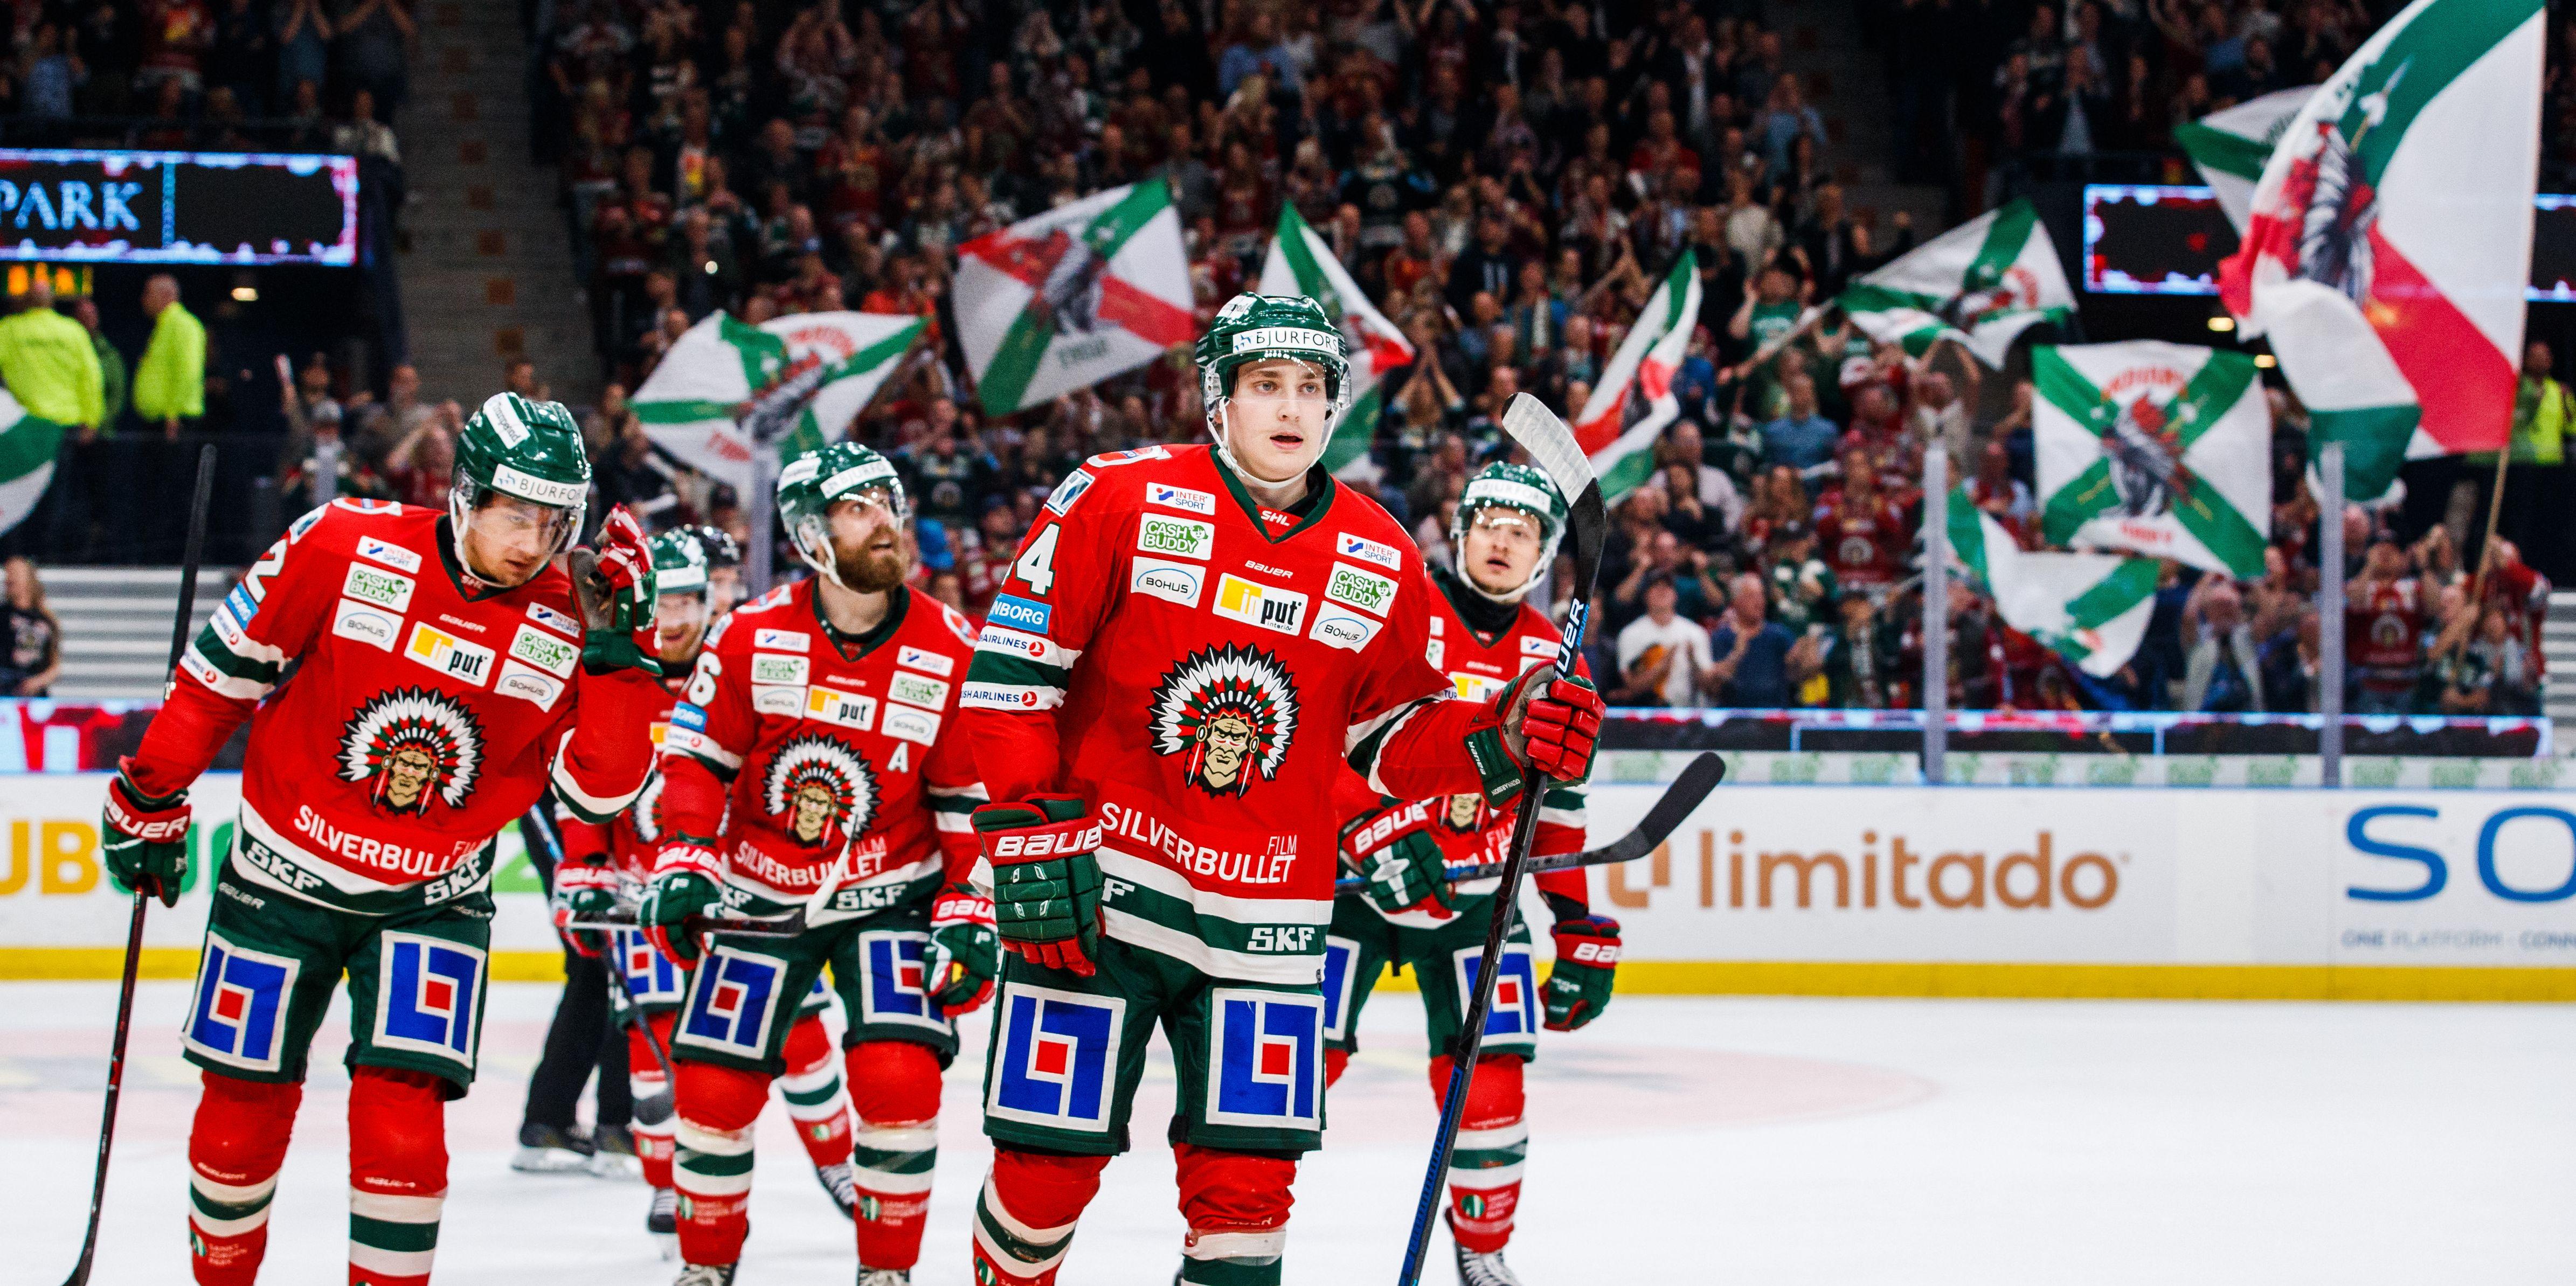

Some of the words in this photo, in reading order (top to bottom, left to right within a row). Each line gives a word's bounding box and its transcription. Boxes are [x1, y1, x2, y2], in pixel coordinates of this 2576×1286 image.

[1256, 329, 1339, 353] BJURFORS
[1175, 498, 1205, 511] SPORT
[1176, 490, 1206, 503] INTER
[1146, 521, 1188, 539] CASH
[1261, 510, 1290, 526] SHL
[1144, 534, 1198, 554] BUDDY
[1365, 543, 1393, 558] INTER
[1002, 523, 1060, 596] 4
[1244, 560, 1293, 579] BAUER
[1365, 551, 1392, 565] SPORT
[349, 580, 397, 604] BUDDY
[352, 569, 392, 592] CASH
[1146, 577, 1189, 594] BOHUS
[1336, 571, 1375, 593] CASH
[1241, 588, 1298, 626] input
[1331, 582, 1382, 609] BUDDY
[991, 600, 1045, 625] NBORG
[347, 619, 386, 638] BOHUS
[1324, 624, 1360, 641] BOHUS
[515, 642, 563, 669] BUDDY
[520, 632, 559, 656] CASH
[509, 677, 546, 697] BOHUS
[682, 651, 723, 708] 6
[887, 741, 909, 773] A
[1468, 741, 1486, 775] BAUER
[294, 804, 474, 877] SILVERBULL
[994, 824, 1102, 857] BAUE
[1354, 803, 1428, 854] BAUE
[856, 836, 887, 856] ILM
[1098, 802, 1296, 884] SILVERBULLET
[1266, 835, 1297, 855] FILM
[246, 841, 322, 892] SKF
[735, 840, 887, 887] SILVERBULET
[1699, 829, 2120, 910] limitado
[424, 851, 482, 906] SKF
[723, 887, 753, 909] KF
[836, 883, 907, 910] SKF
[936, 899, 996, 922] BAU
[1247, 927, 1315, 952] SKF
[1573, 942, 1618, 963] BA
